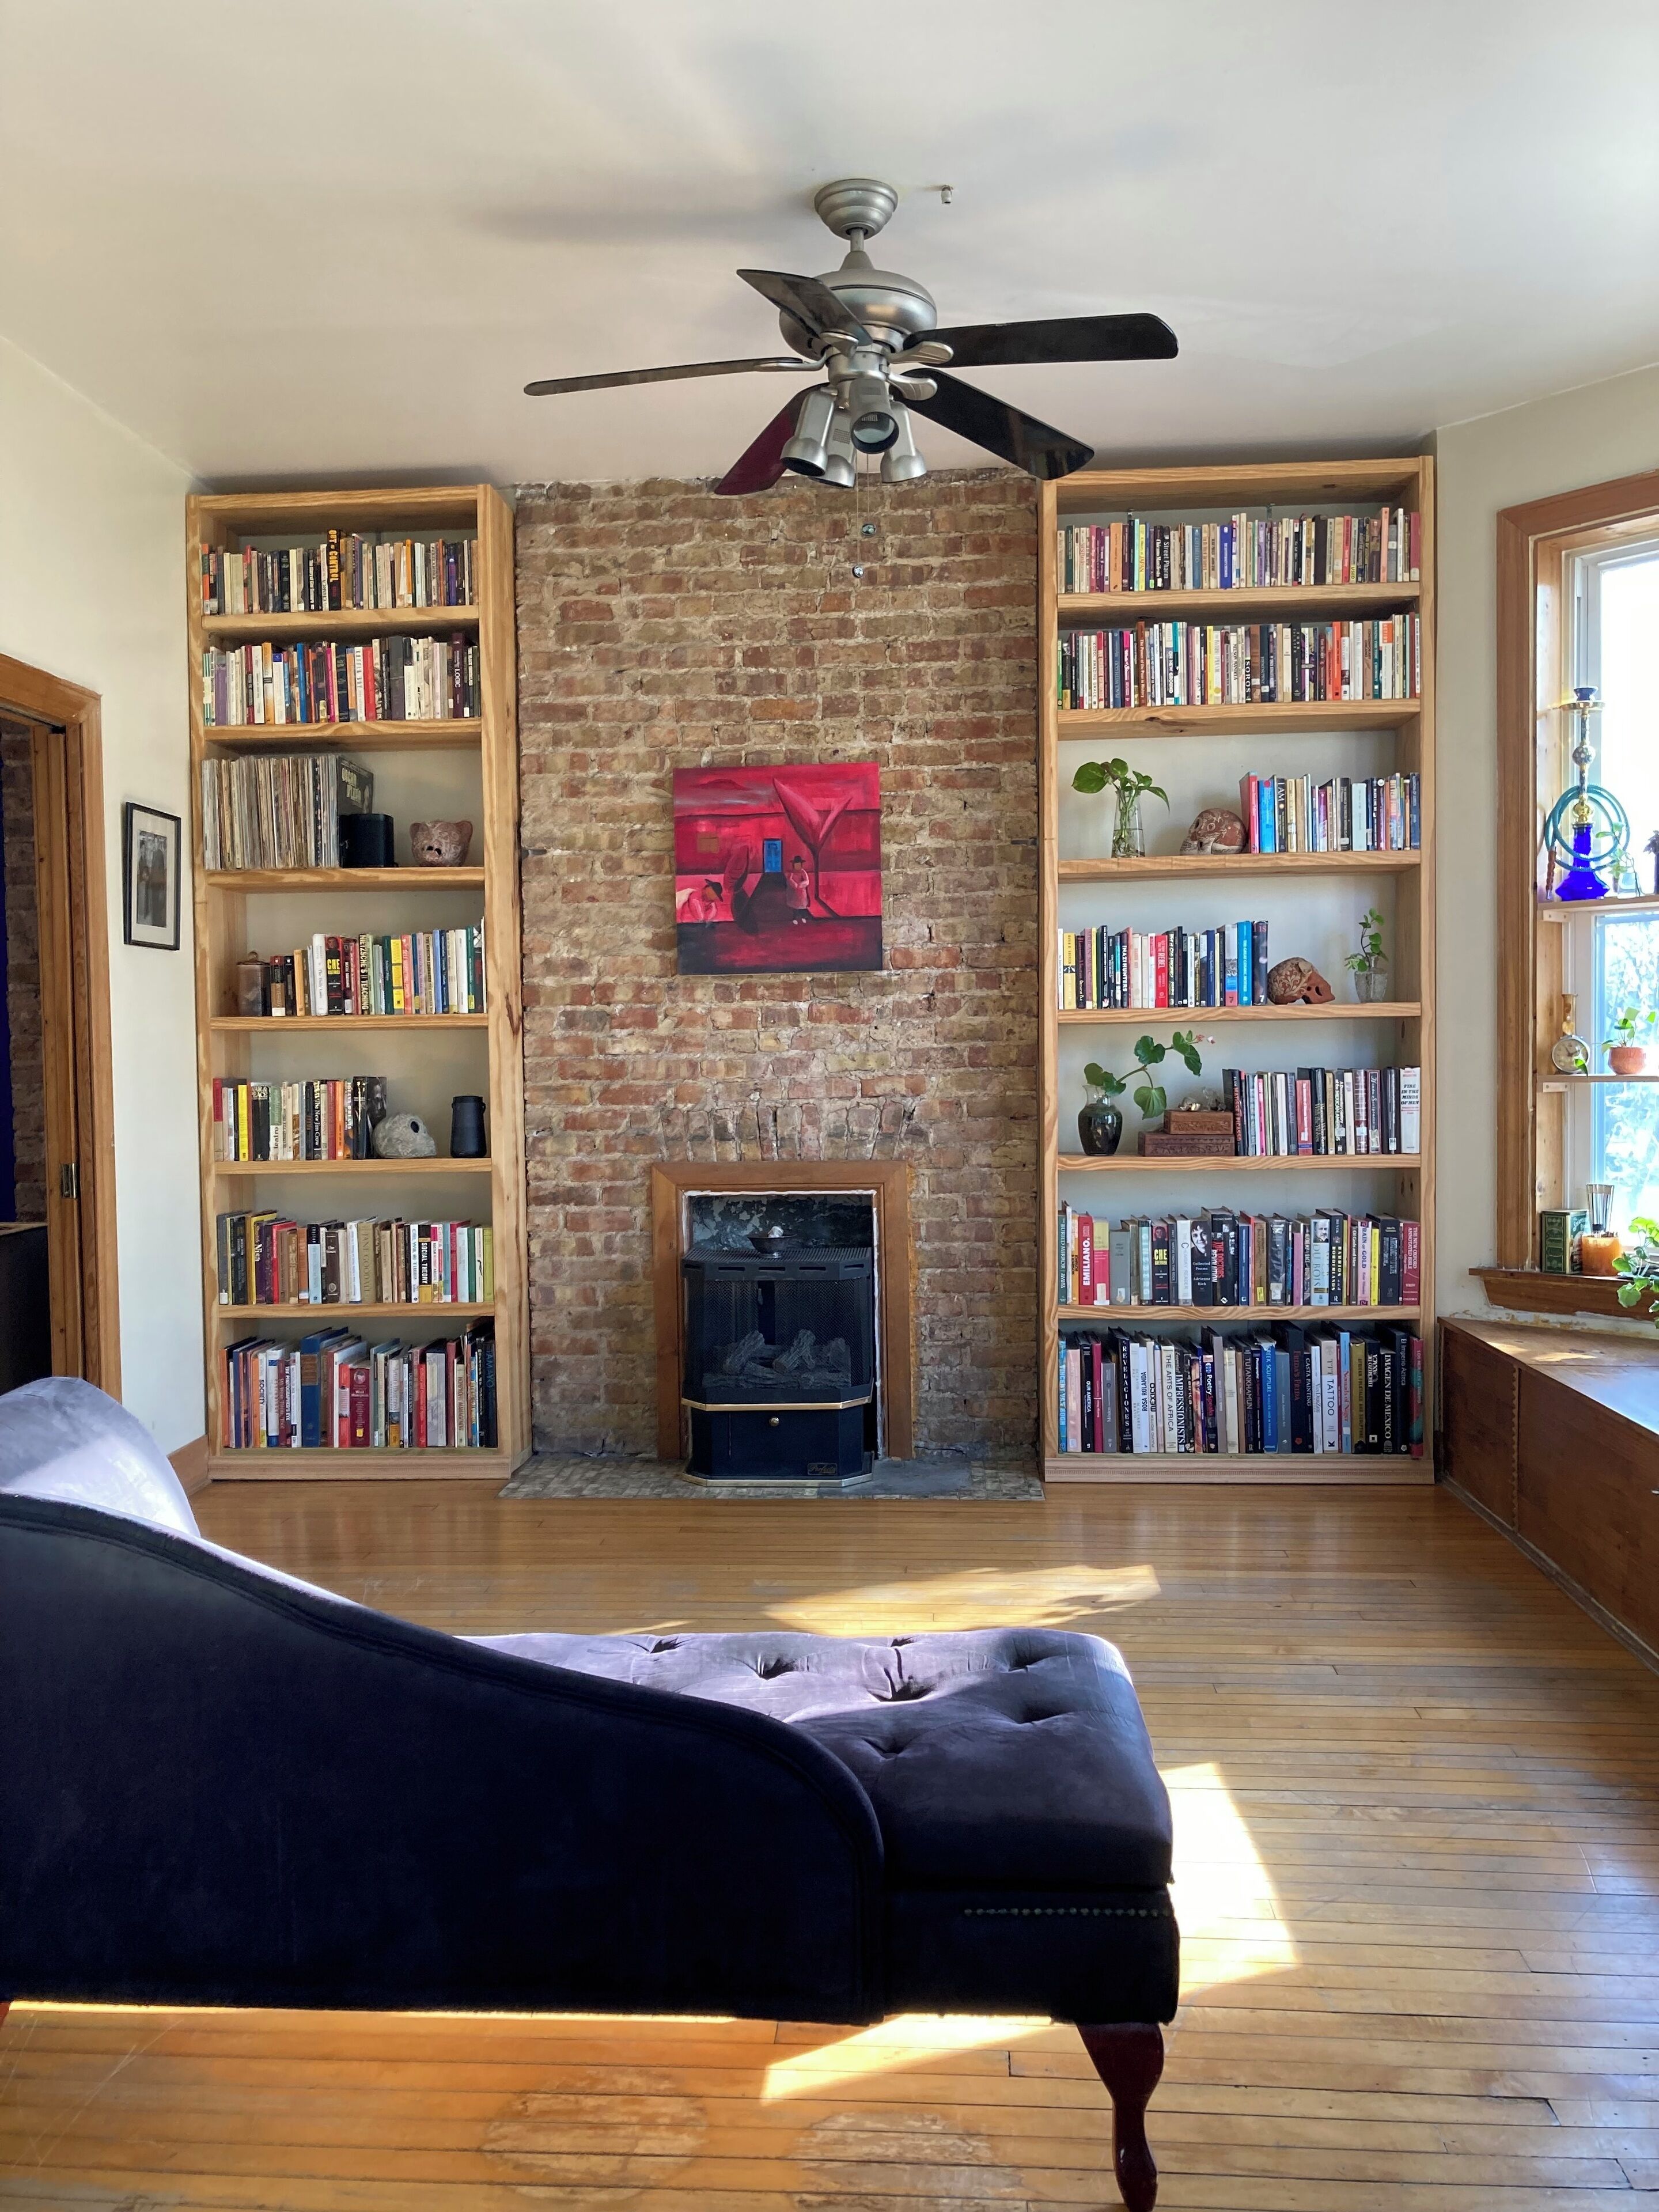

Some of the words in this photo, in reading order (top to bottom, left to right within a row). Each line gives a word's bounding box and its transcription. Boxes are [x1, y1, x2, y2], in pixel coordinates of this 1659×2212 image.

[328, 530, 338, 543] OUT
[329, 551, 340, 582] CONTROL
[1168, 651, 1172, 659] ON
[1278, 787, 1285, 801] AM
[359, 934, 368, 974] NIETZSCHE'S
[362, 1234, 370, 1251] JANE
[1215, 1242, 1224, 1252] THE
[1154, 1249, 1168, 1260] CHE
[1313, 1244, 1320, 1259] DU
[363, 1255, 371, 1291] GOODALL
[1313, 1264, 1322, 1286] BOIS
[486, 1350, 494, 1388] TAMAYO
[1167, 1392, 1173, 1402] OF
[1294, 1379, 1302, 1400] FRIDA
[1385, 1391, 1391, 1402] DE
[1176, 1374, 1185, 1444] IMPRESSIONISTS
